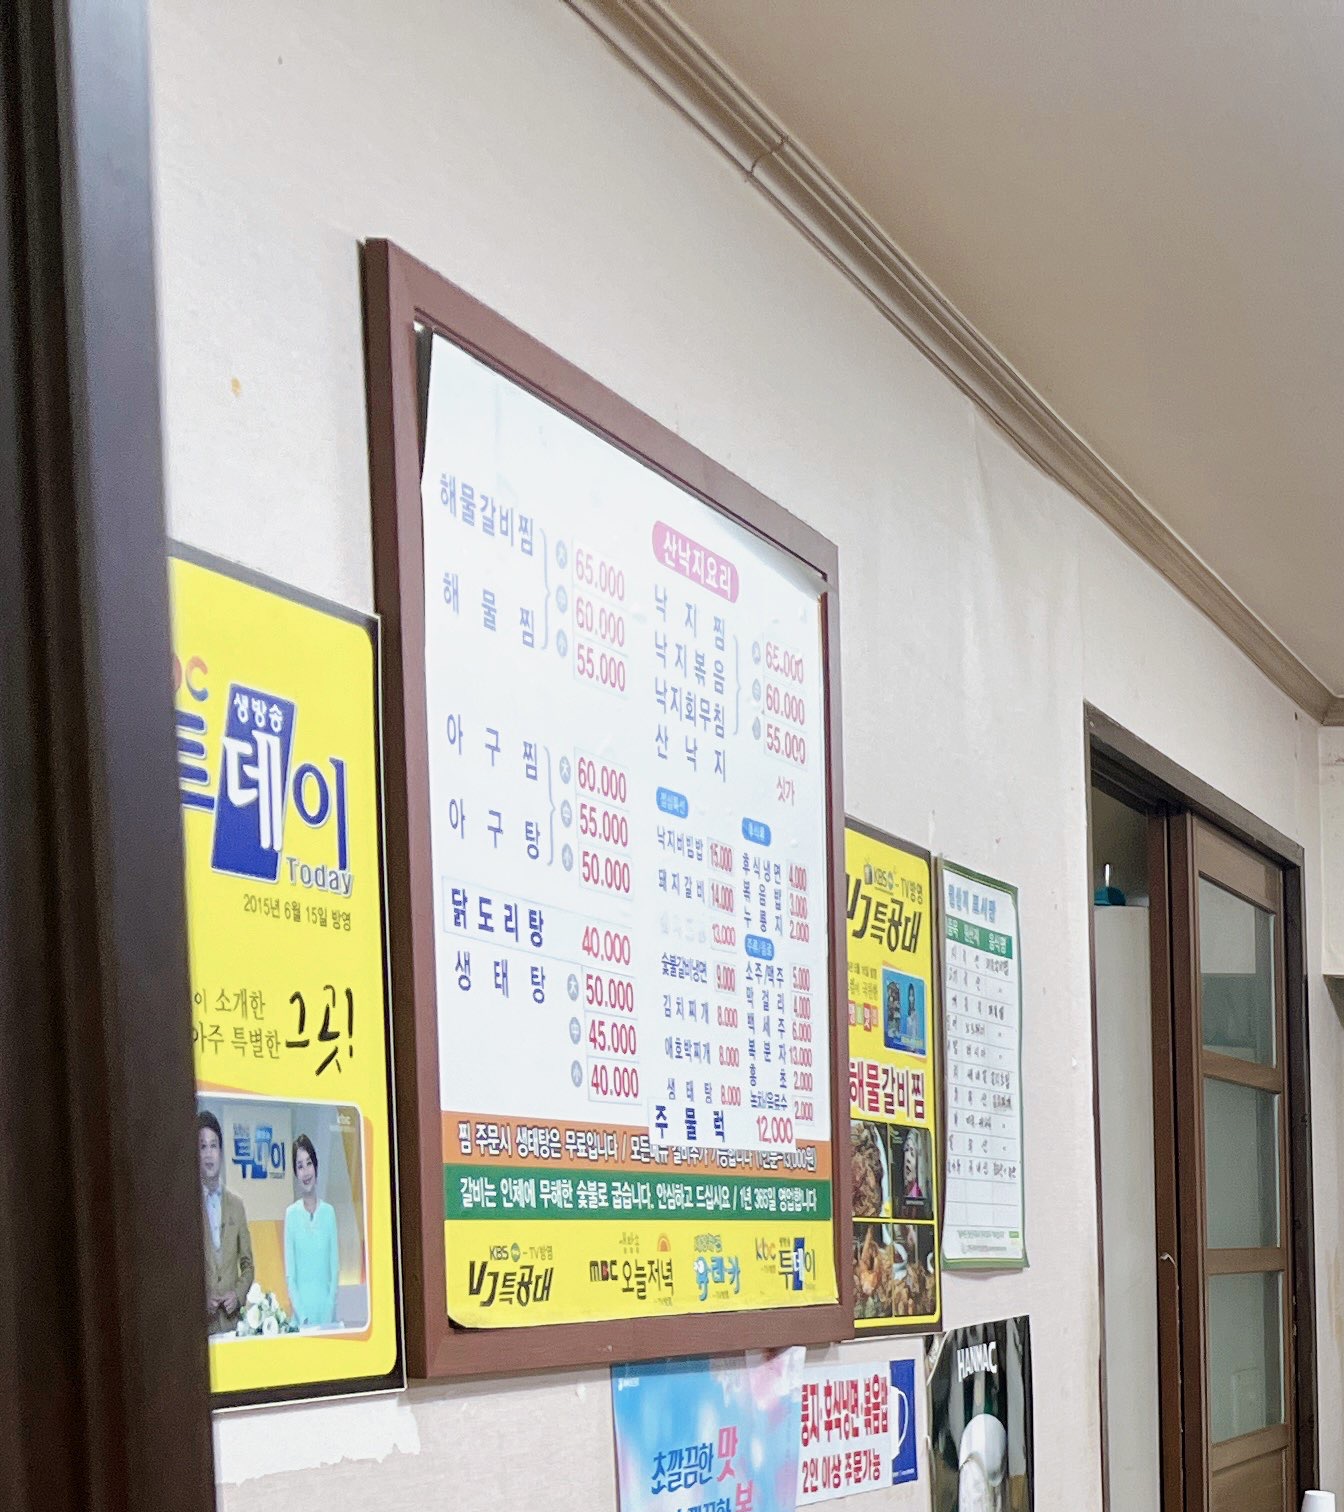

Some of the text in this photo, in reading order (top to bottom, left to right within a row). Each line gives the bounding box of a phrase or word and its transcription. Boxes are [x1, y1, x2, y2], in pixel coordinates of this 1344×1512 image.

[440, 473, 533, 556] 해물갈비찜
[664, 531, 731, 599] 산낙지요리
[234, 692, 284, 733] 생방송
[286, 855, 354, 898] Today
[243, 893, 351, 931] 2015년 6월 15일 방영
[215, 987, 265, 1021] 소개한
[230, 1026, 281, 1059] 특별한
[848, 1061, 925, 1119] 해물갈비찜
[458, 1121, 618, 1161] 찜 주문시 생태탕은 무료입니다
[460, 1177, 497, 1208] 갈비는
[500, 1178, 536, 1209] 인체에
[540, 1179, 573, 1209] 무해한
[576, 1180, 609, 1210] 숯불로
[656, 1182, 694, 1210] 안심하고
[468, 1261, 554, 1307] VJ특공대
[621, 1258, 674, 1300] 오늘저녁
[957, 1341, 998, 1383] HANMAC
[651, 1426, 738, 1494] 초깔끔한 맛
[802, 1449, 881, 1493] 2인 이상 주문가능
